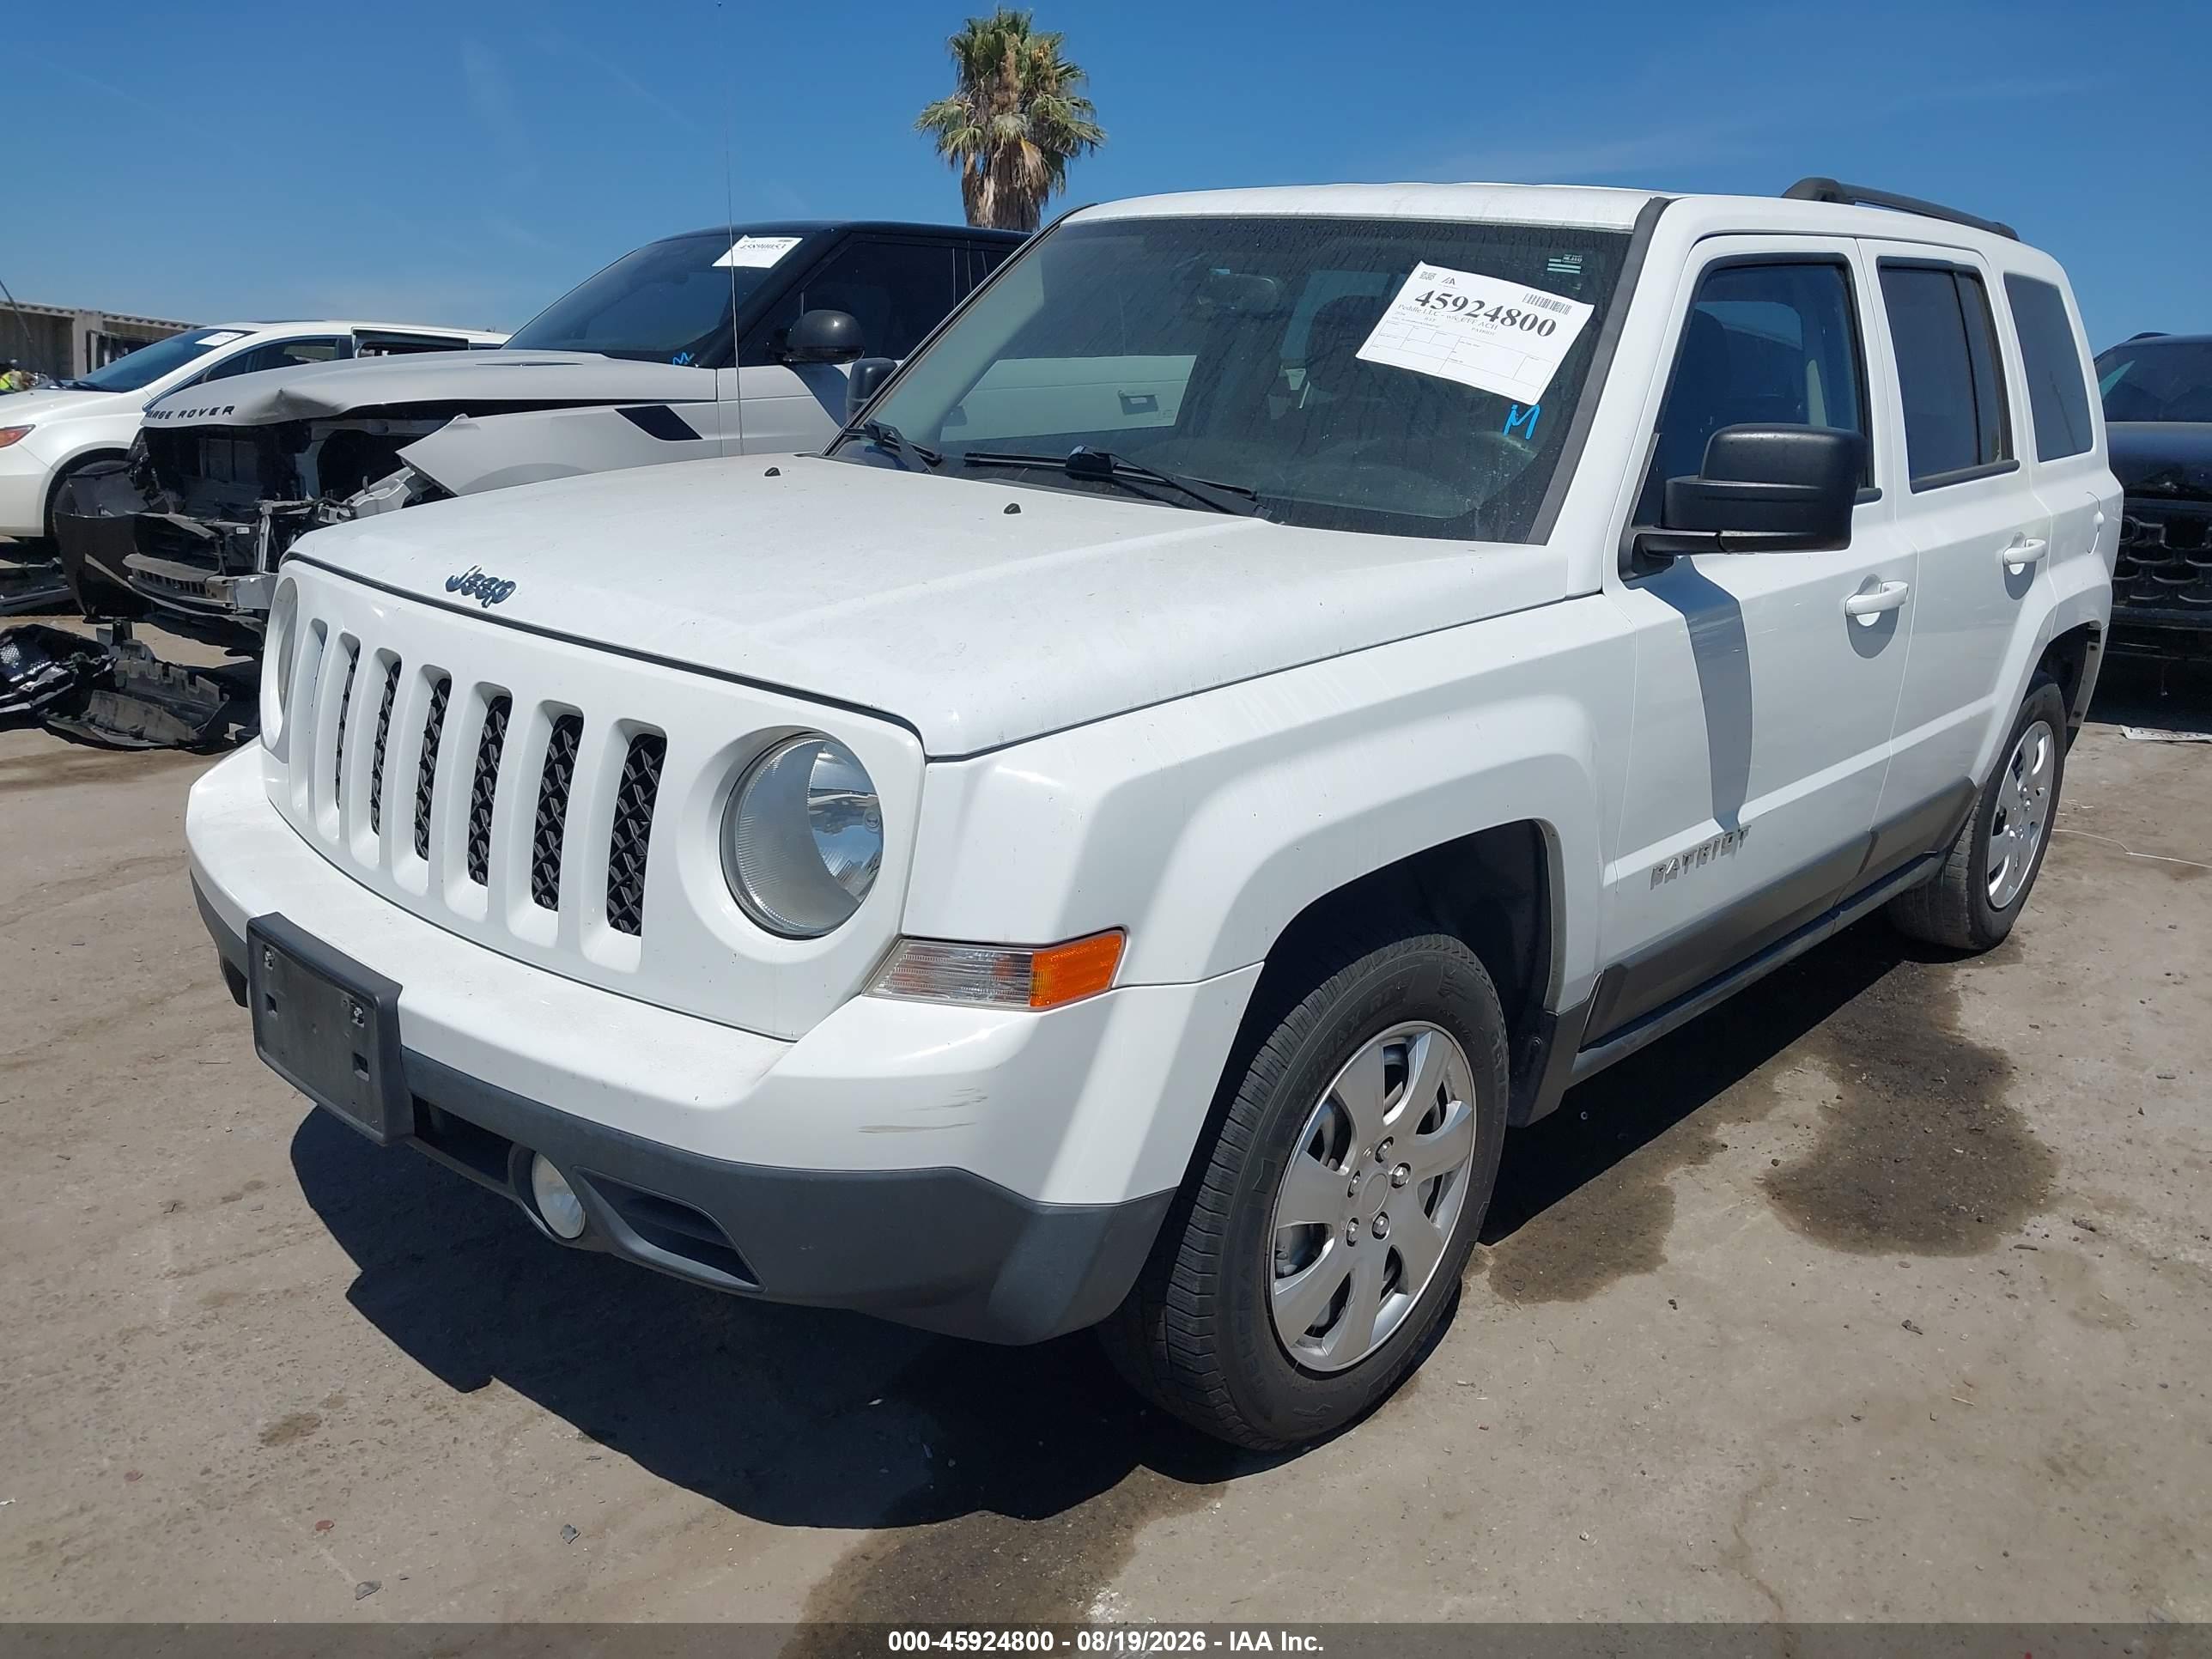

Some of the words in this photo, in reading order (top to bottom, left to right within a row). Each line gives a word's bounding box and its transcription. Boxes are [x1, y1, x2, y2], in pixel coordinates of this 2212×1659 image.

[1414, 290, 1557, 337] 45924800
[178, 405, 234, 418] ROVER
[1503, 404, 1540, 440] M
[445, 564, 517, 609] Jeep
[1650, 824, 1752, 890] PATRIOT
